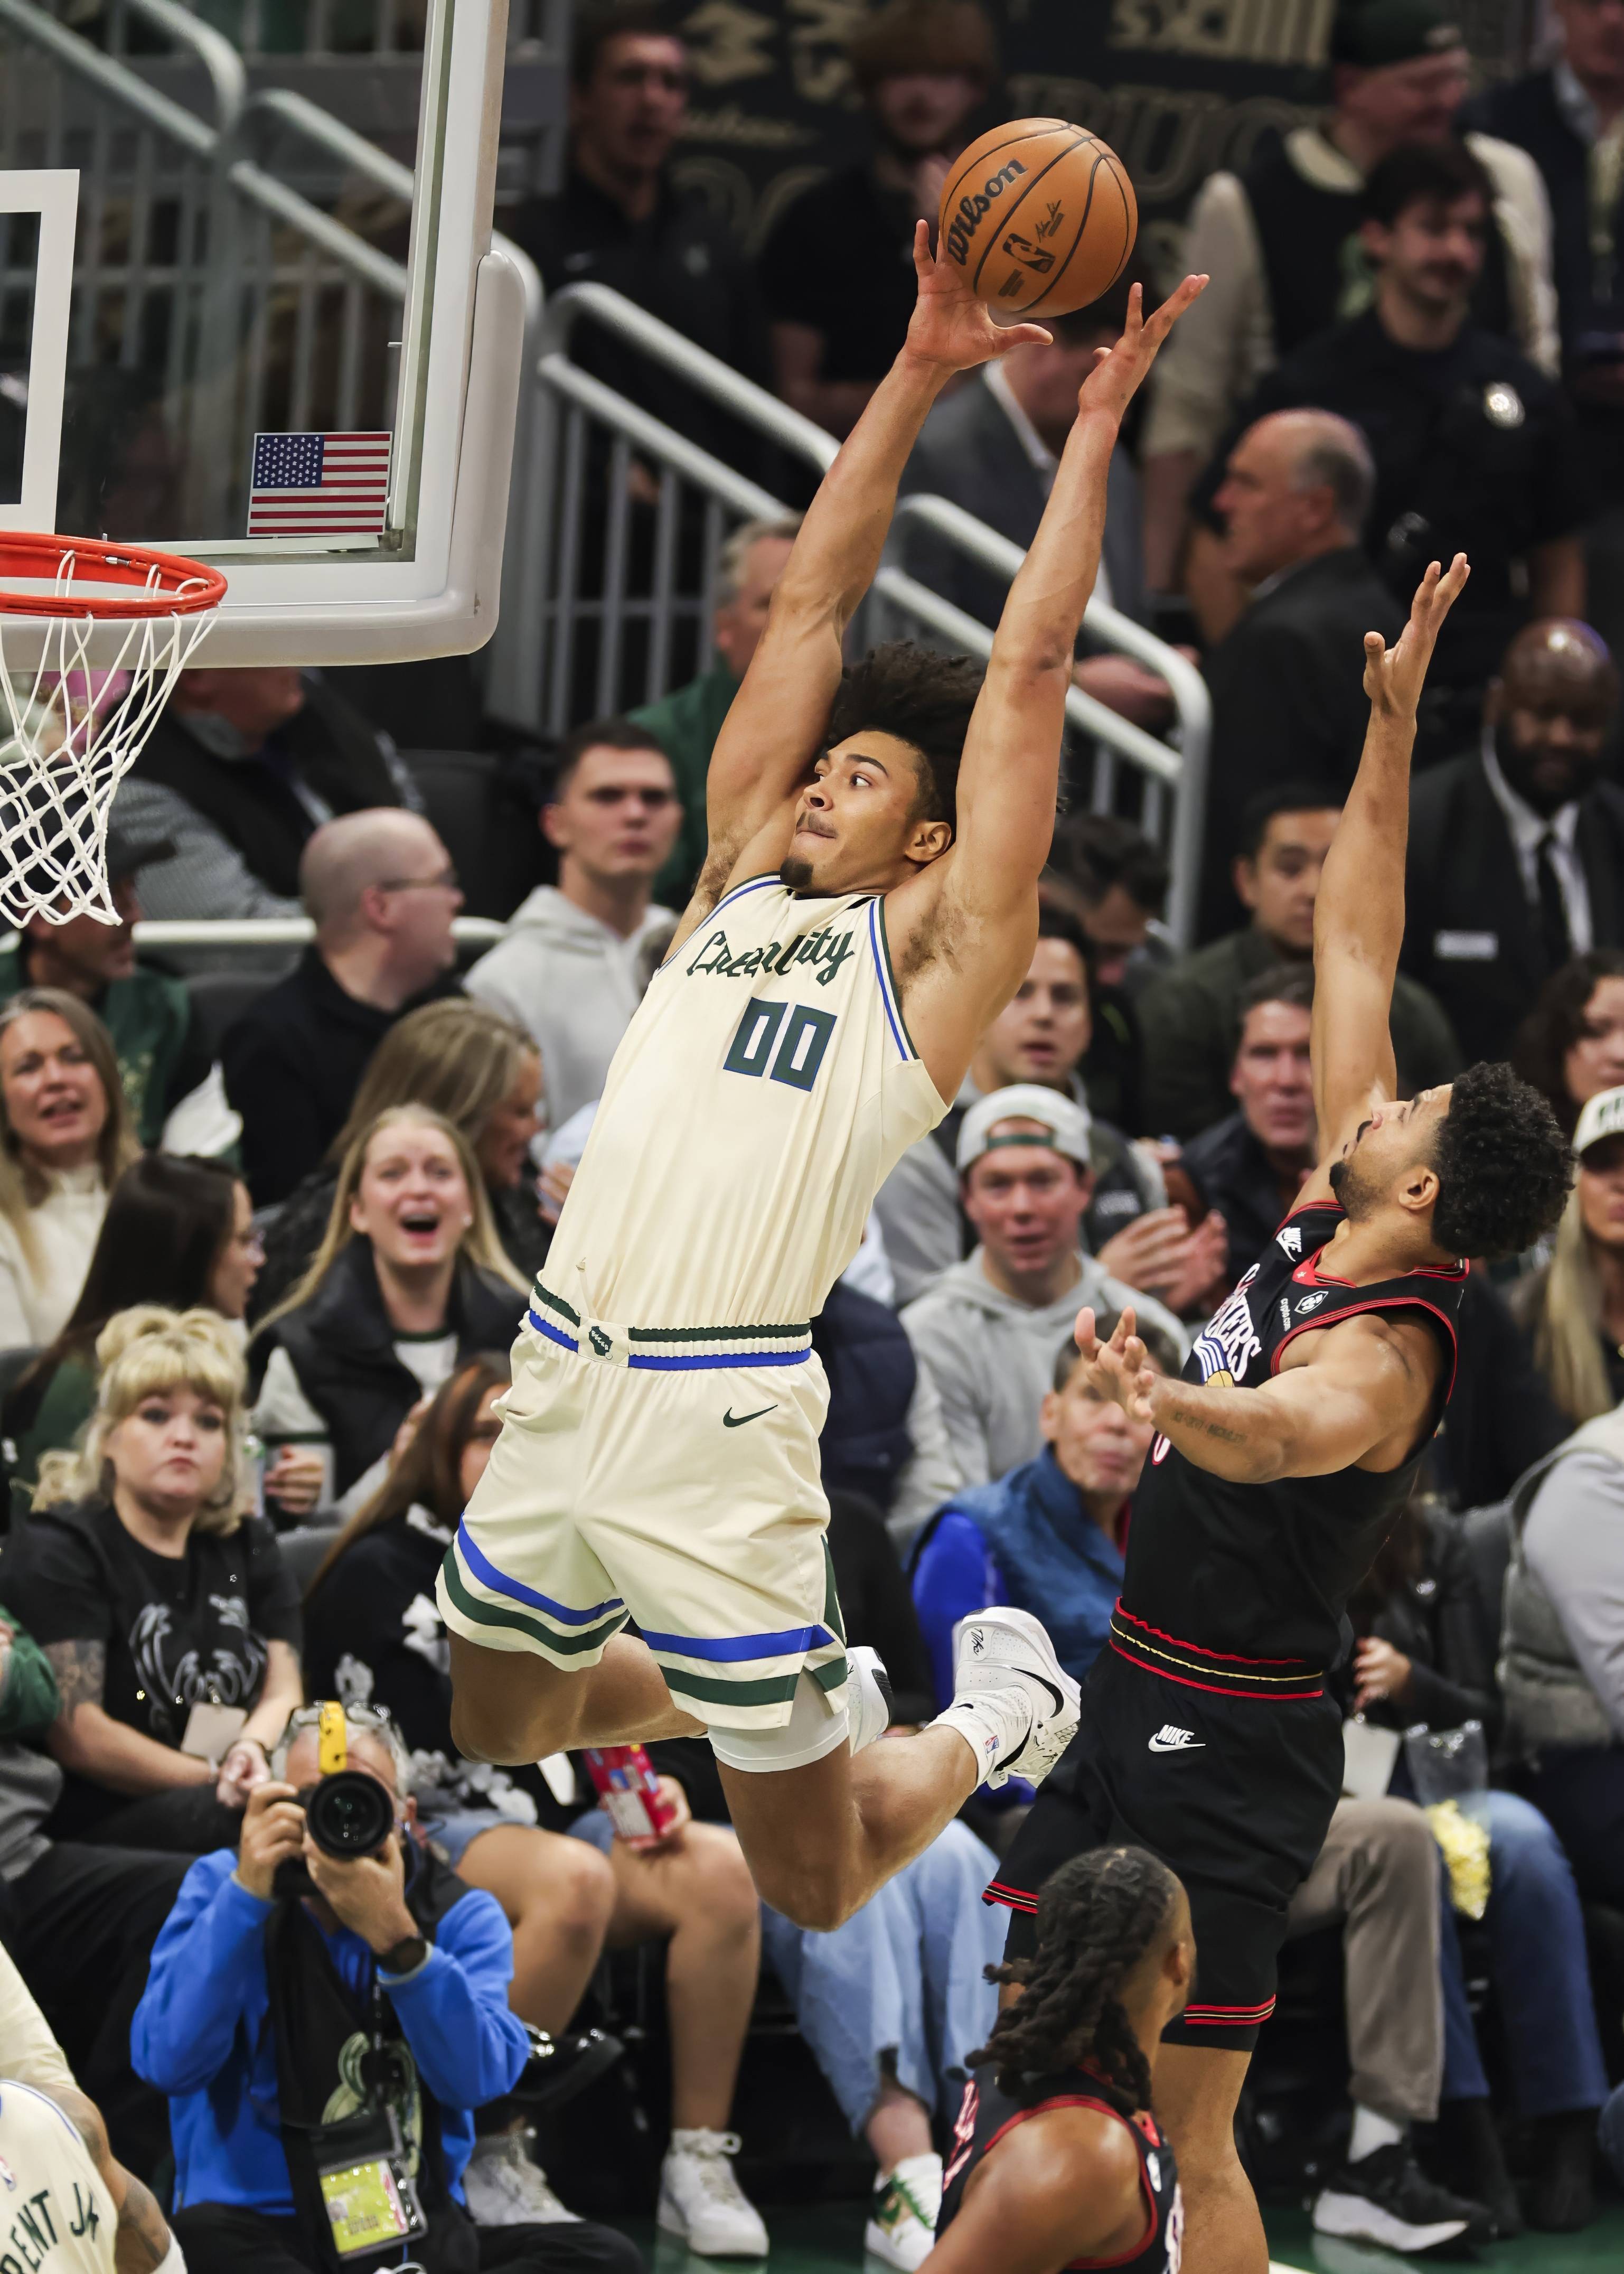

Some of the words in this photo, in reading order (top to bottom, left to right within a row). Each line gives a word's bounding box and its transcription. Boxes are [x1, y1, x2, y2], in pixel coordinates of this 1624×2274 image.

[947, 158, 1028, 266] Wilson
[722, 996, 838, 1092] 00
[1156, 1724, 1195, 1745] NIKE
